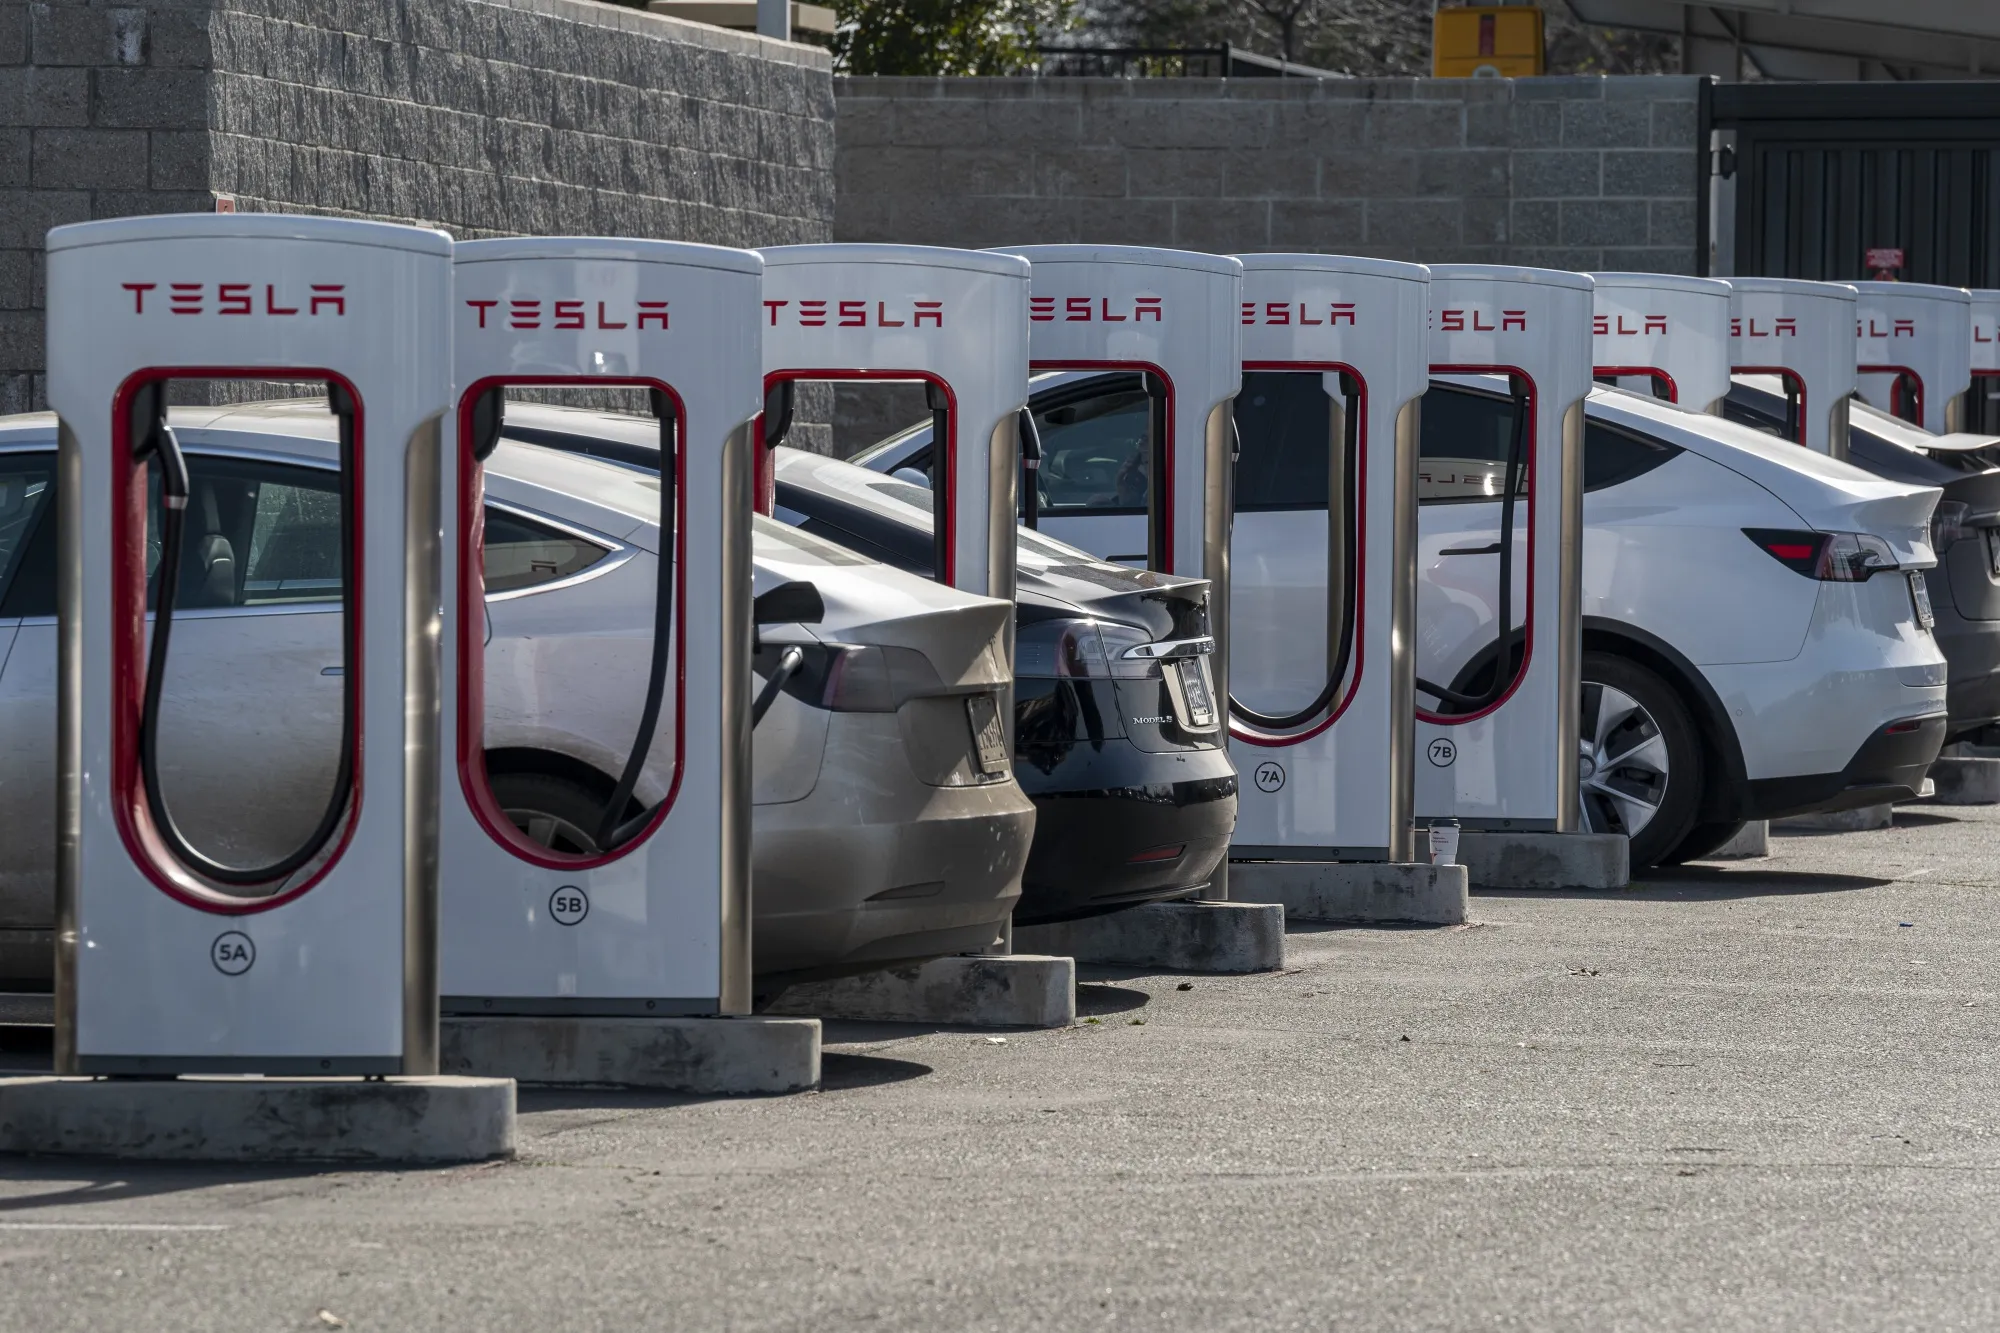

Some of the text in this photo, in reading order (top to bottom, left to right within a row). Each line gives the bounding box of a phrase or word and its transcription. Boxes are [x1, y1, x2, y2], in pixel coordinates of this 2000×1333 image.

[121, 283, 345, 315] TESLA
[466, 300, 669, 330] TESLA
[763, 301, 943, 328] TESLA
[1030, 297, 1162, 322] ESLA
[1241, 303, 1356, 325] ESLA
[1429, 310, 1526, 331] SLA
[1593, 315, 1667, 335] SLA
[1132, 716, 1165, 725] MODEL
[1433, 746, 1452, 758] 7B
[1261, 771, 1280, 783] 7A
[556, 897, 582, 913] 5B
[219, 944, 248, 961] 5A
